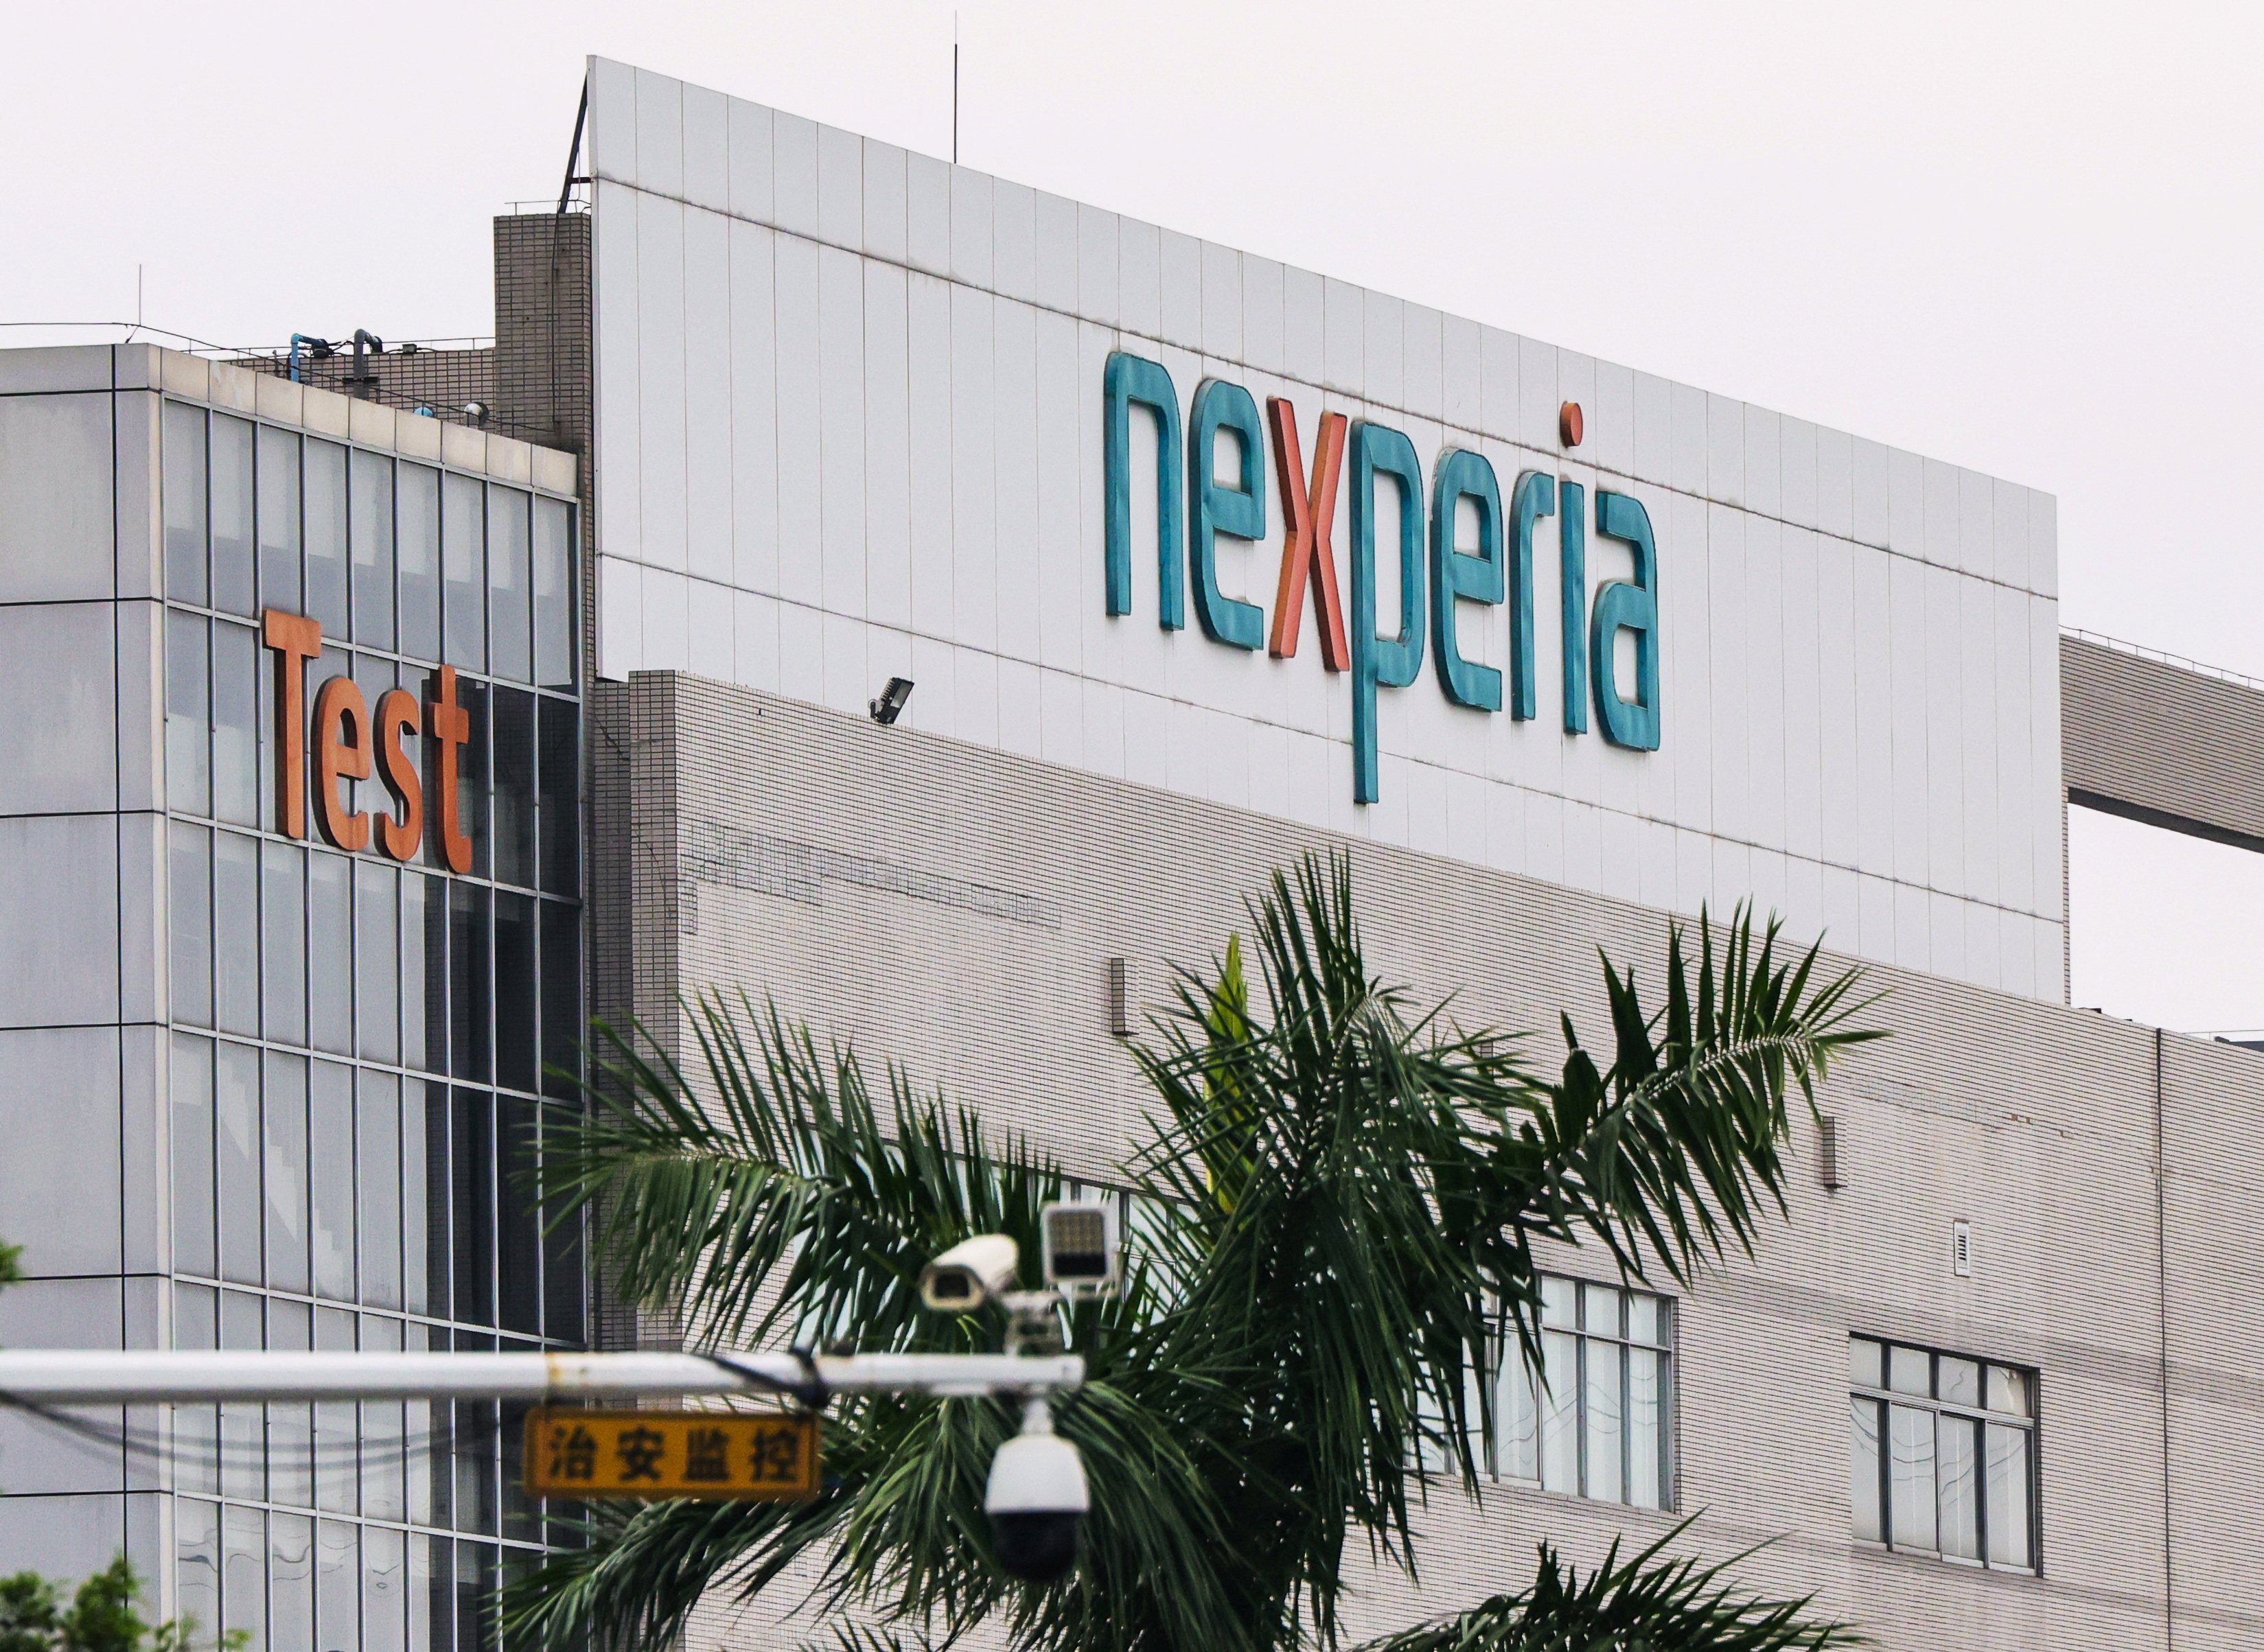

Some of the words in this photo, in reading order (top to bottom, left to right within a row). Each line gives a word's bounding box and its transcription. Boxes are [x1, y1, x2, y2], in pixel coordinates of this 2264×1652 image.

[1104, 351, 1661, 804] nexperia
[262, 608, 472, 874] Test
[550, 1424, 800, 1482] 治安监控
